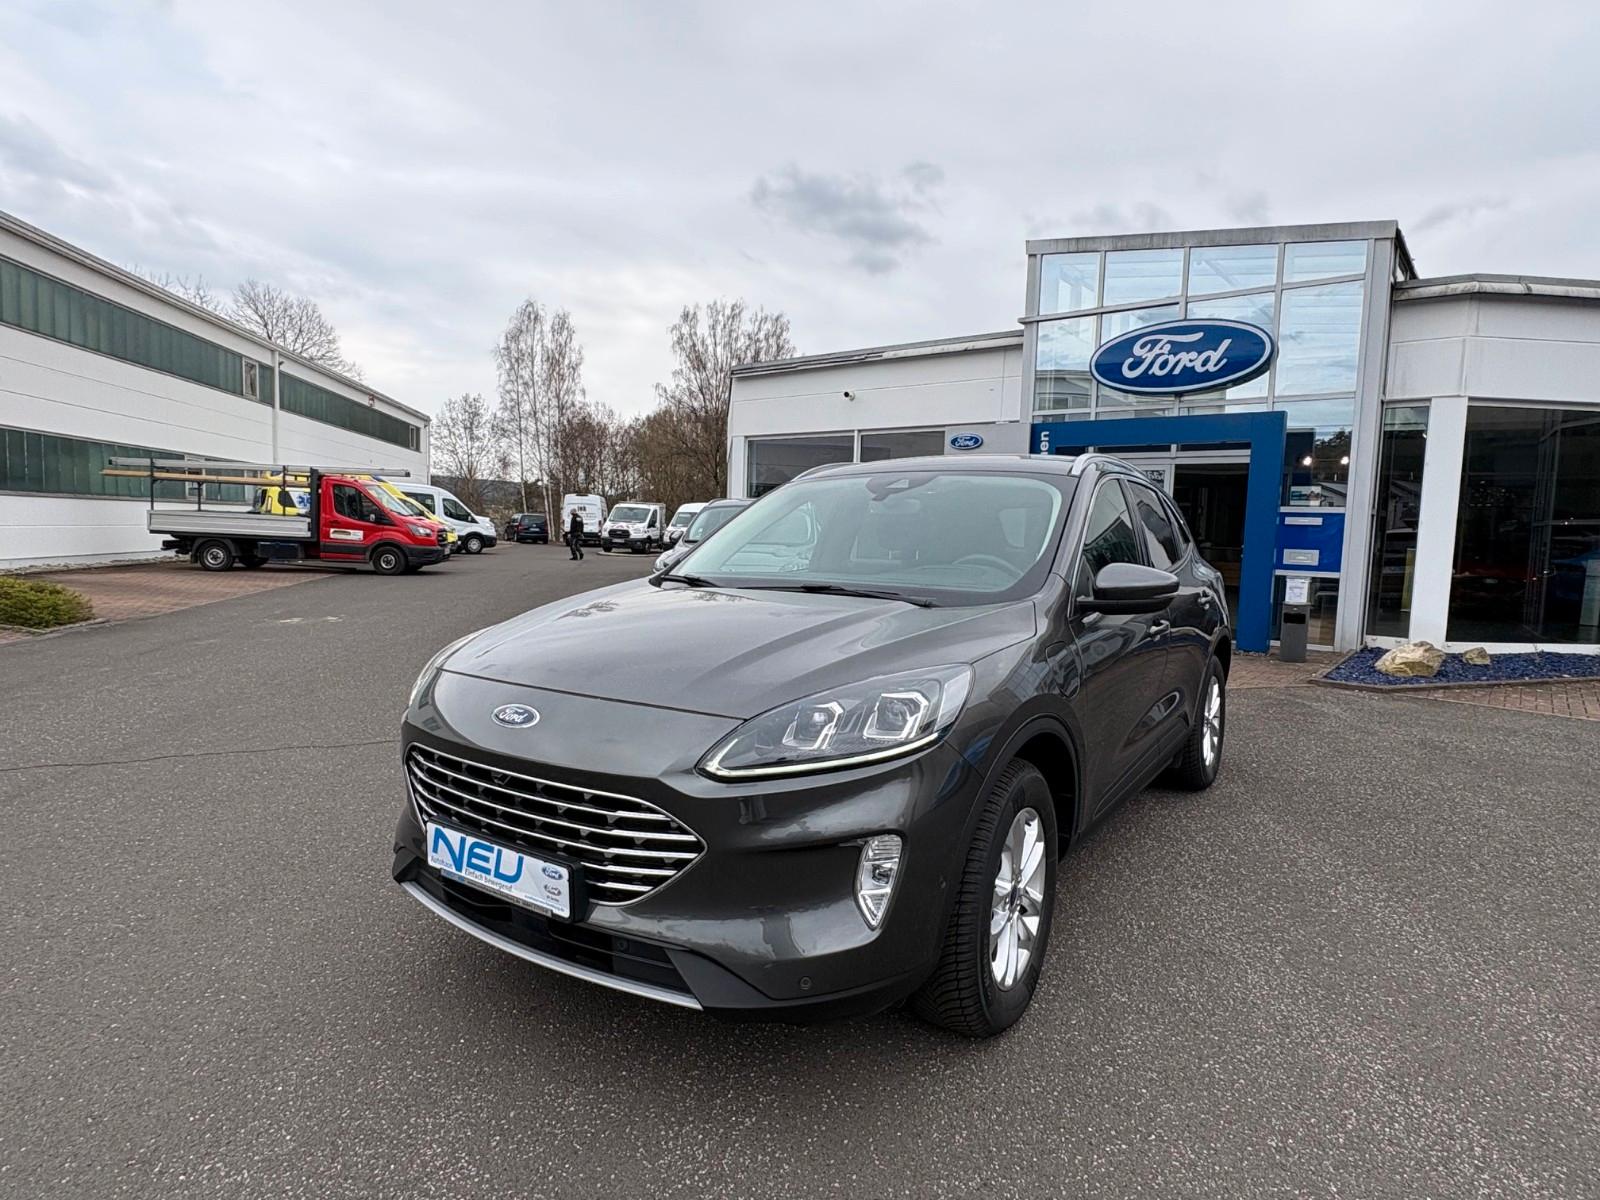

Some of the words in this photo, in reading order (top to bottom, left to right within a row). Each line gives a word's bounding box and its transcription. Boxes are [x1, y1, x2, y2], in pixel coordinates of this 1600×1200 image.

[1122, 332, 1232, 379] Ford
[954, 436, 976, 448] Ford
[499, 707, 529, 722] Ford
[432, 827, 525, 884] NEU
